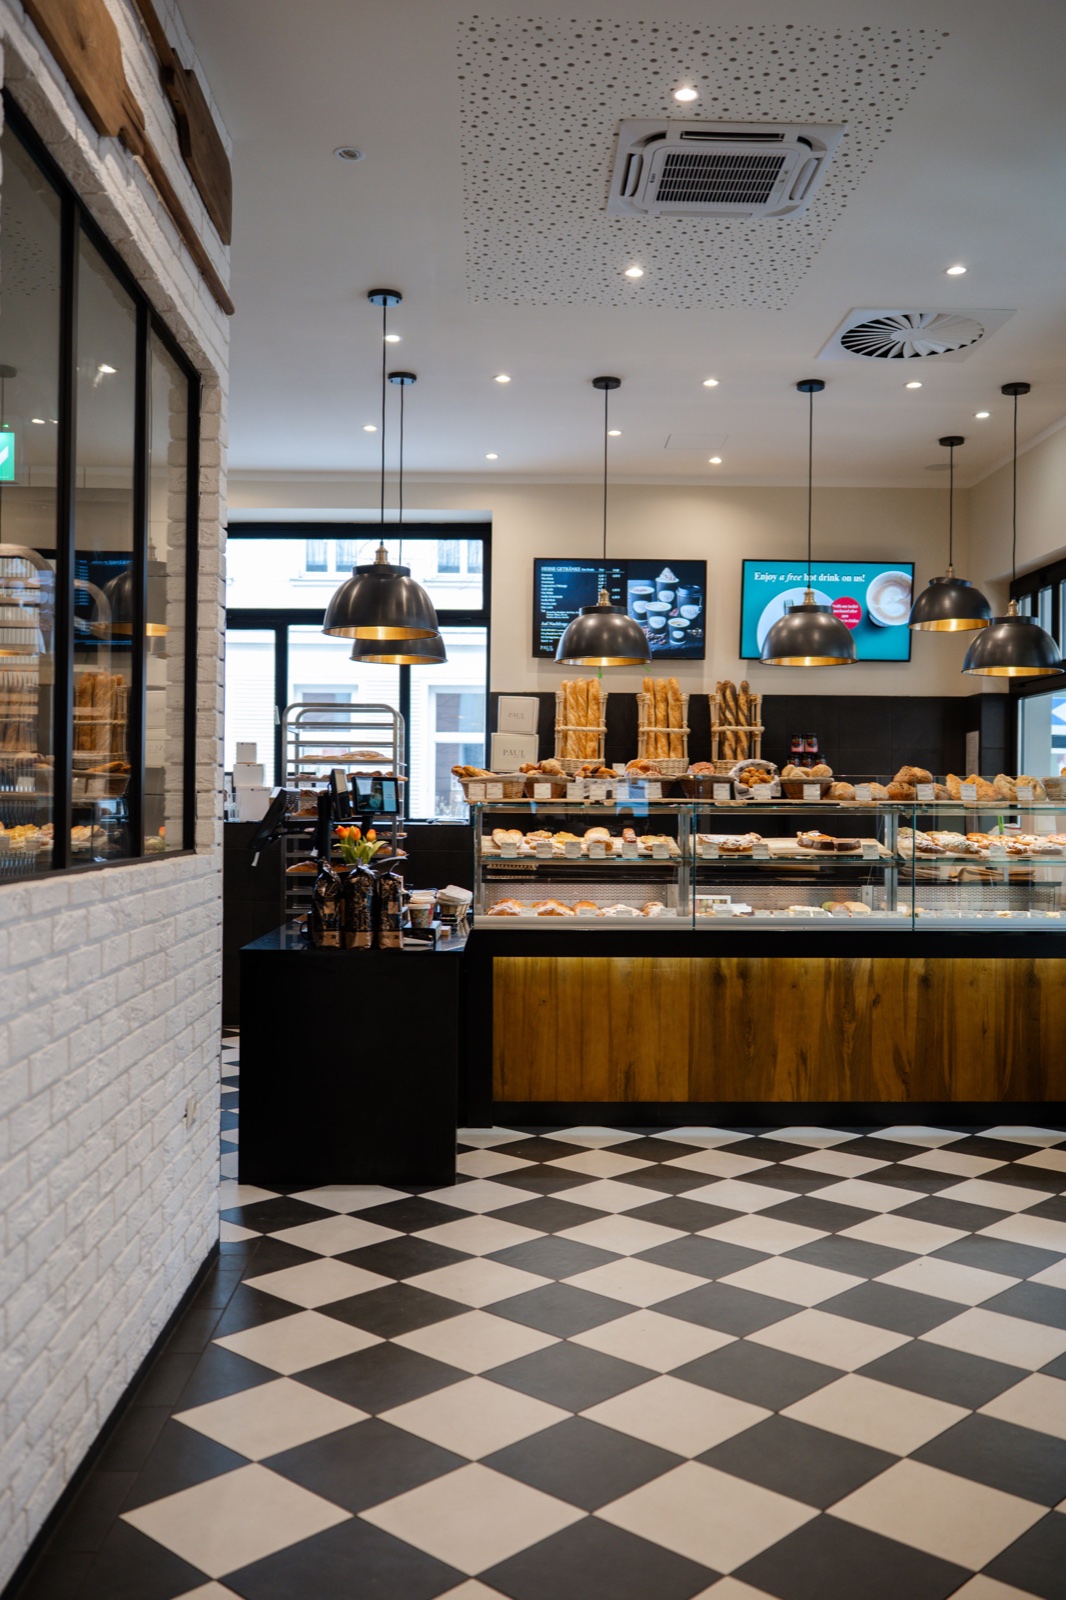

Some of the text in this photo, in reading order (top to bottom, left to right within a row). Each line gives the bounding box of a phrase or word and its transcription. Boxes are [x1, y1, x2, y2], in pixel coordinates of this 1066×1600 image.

[754, 572, 777, 582] Enjoy
[785, 573, 802, 583] free
[818, 573, 840, 582] drink
[853, 573, 866, 582] us!
